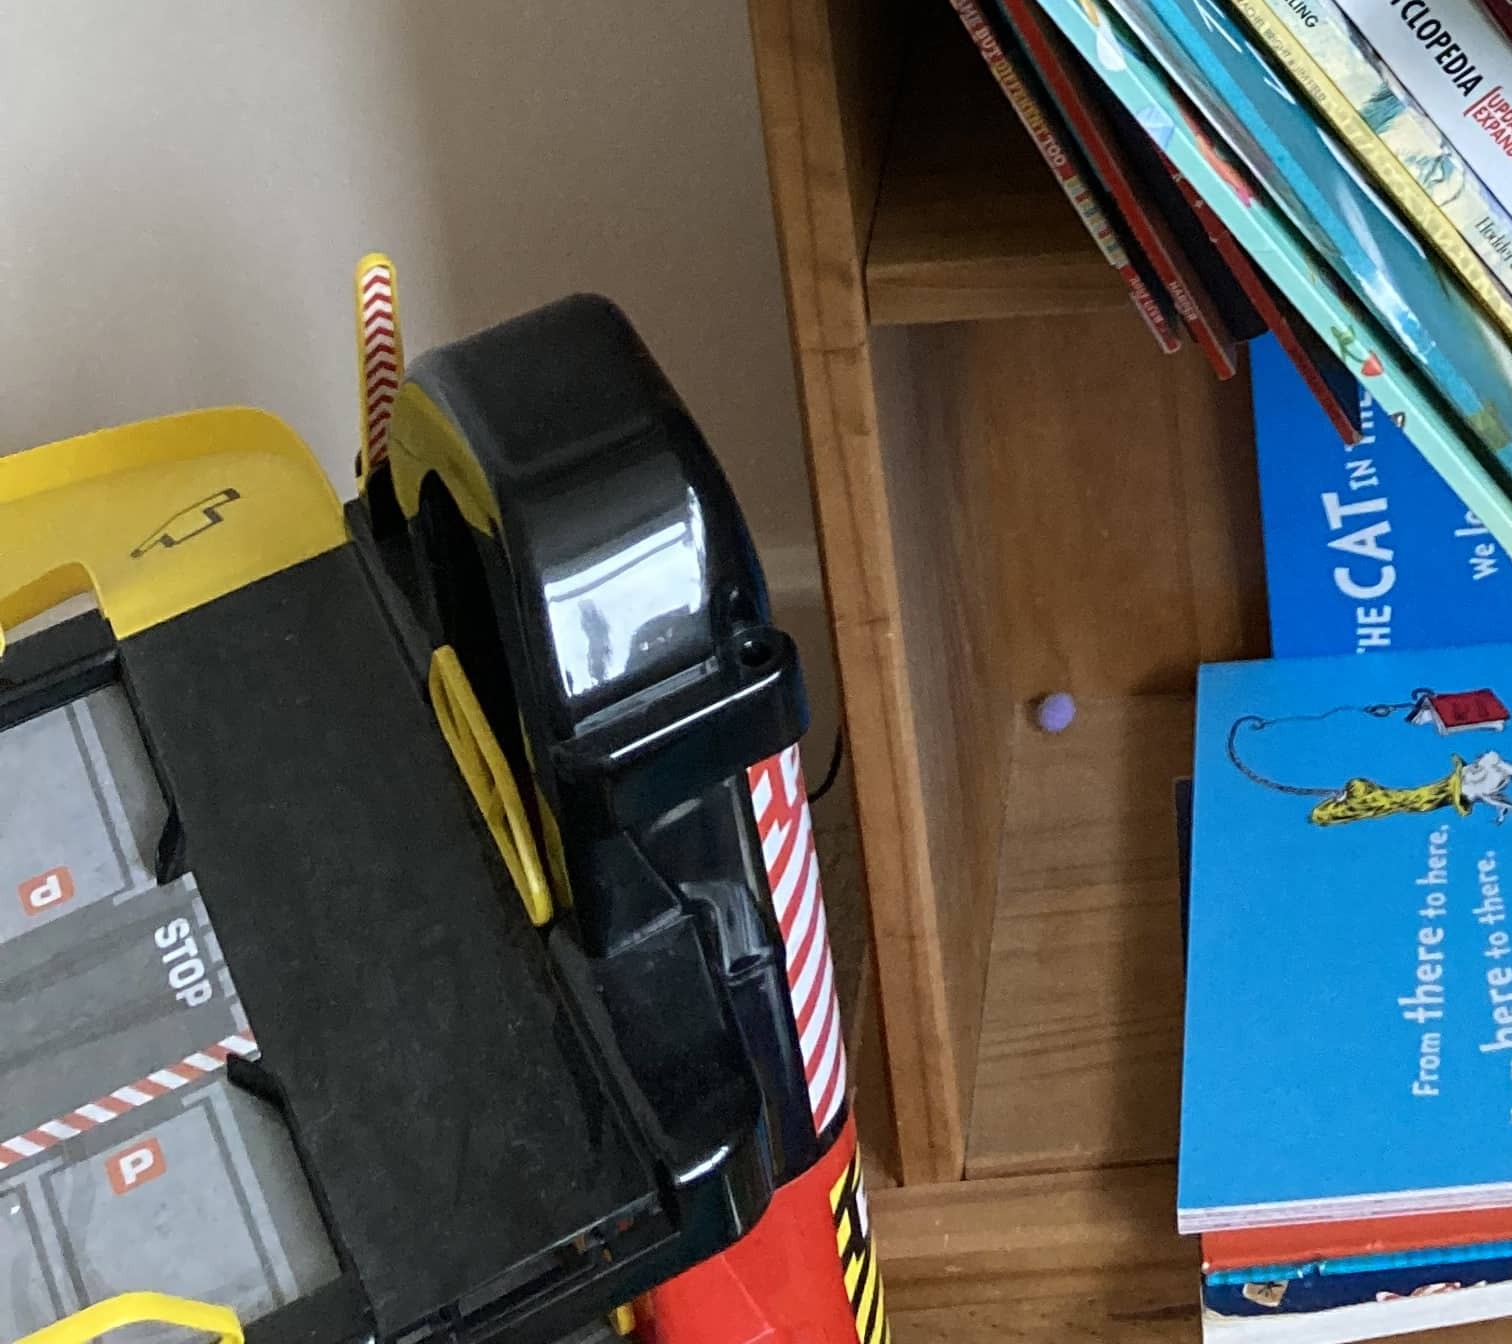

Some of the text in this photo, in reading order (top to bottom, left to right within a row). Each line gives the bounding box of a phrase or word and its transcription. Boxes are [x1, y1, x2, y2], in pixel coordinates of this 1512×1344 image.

[1323, 460, 1396, 652] HE CAT IN
[30, 874, 63, 908] P
[1421, 893, 1446, 918] to
[153, 916, 212, 1009] STOP
[1484, 933, 1508, 959] to
[1398, 928, 1442, 1023] there
[1412, 1033, 1440, 1096] From
[119, 1147, 154, 1186] P
